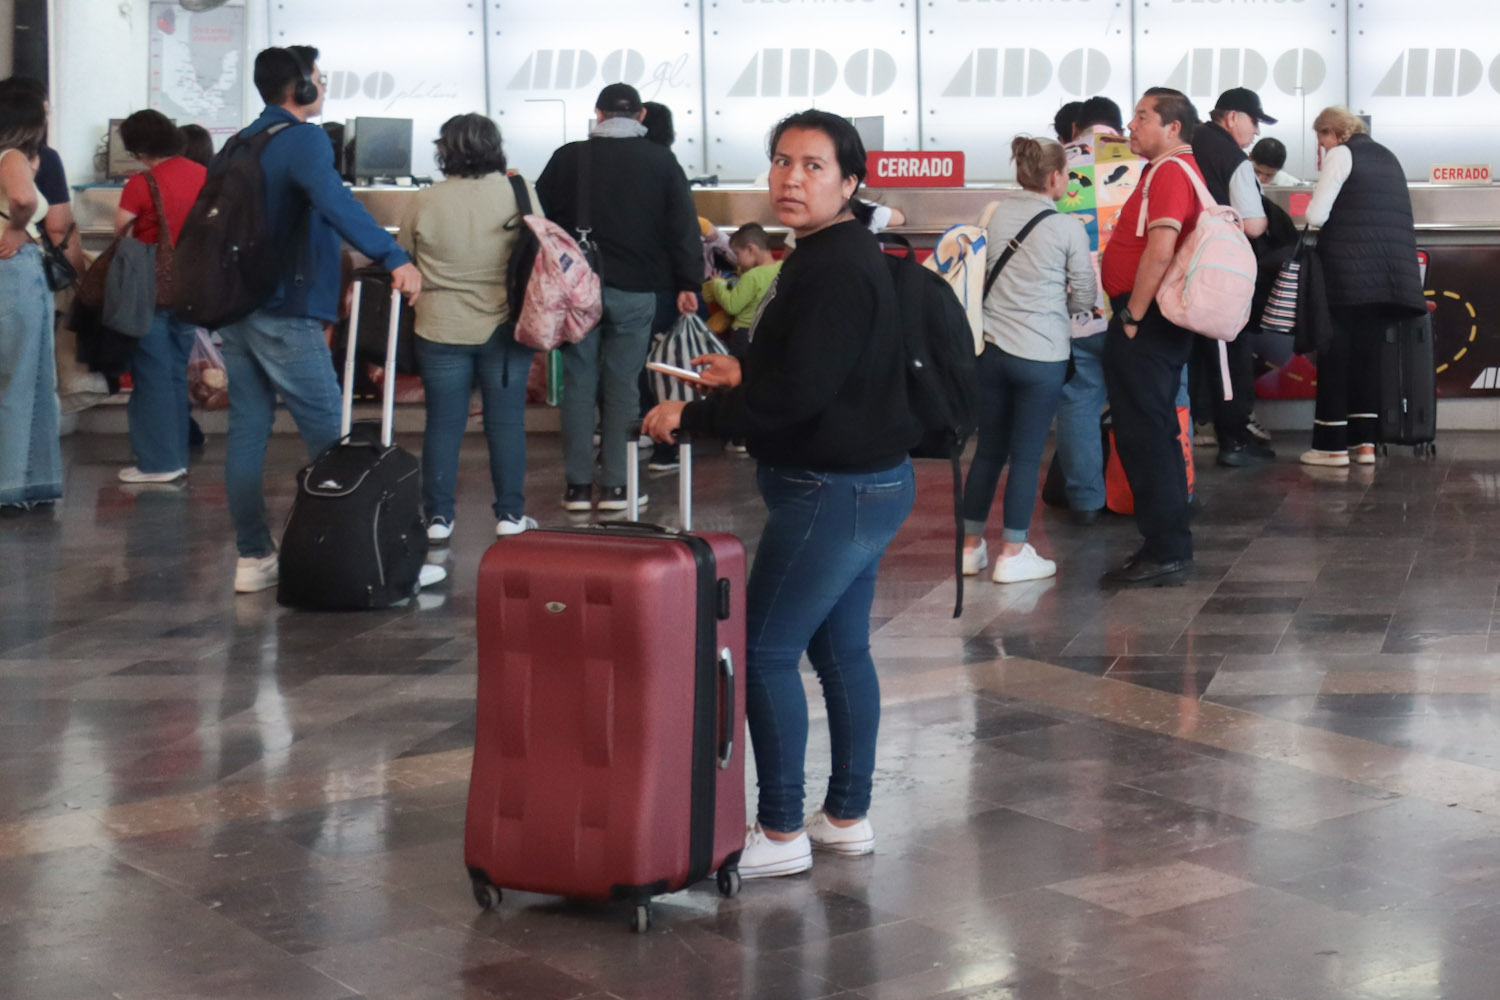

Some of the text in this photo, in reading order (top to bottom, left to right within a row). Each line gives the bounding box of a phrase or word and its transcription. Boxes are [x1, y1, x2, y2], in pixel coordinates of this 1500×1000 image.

[504, 49, 645, 90] ADO
[726, 48, 897, 97] ADO
[941, 48, 1112, 97] ADO
[1161, 48, 1326, 97] ADO
[877, 157, 953, 178] CERRADO
[1433, 167, 1489, 180] CERRADO
